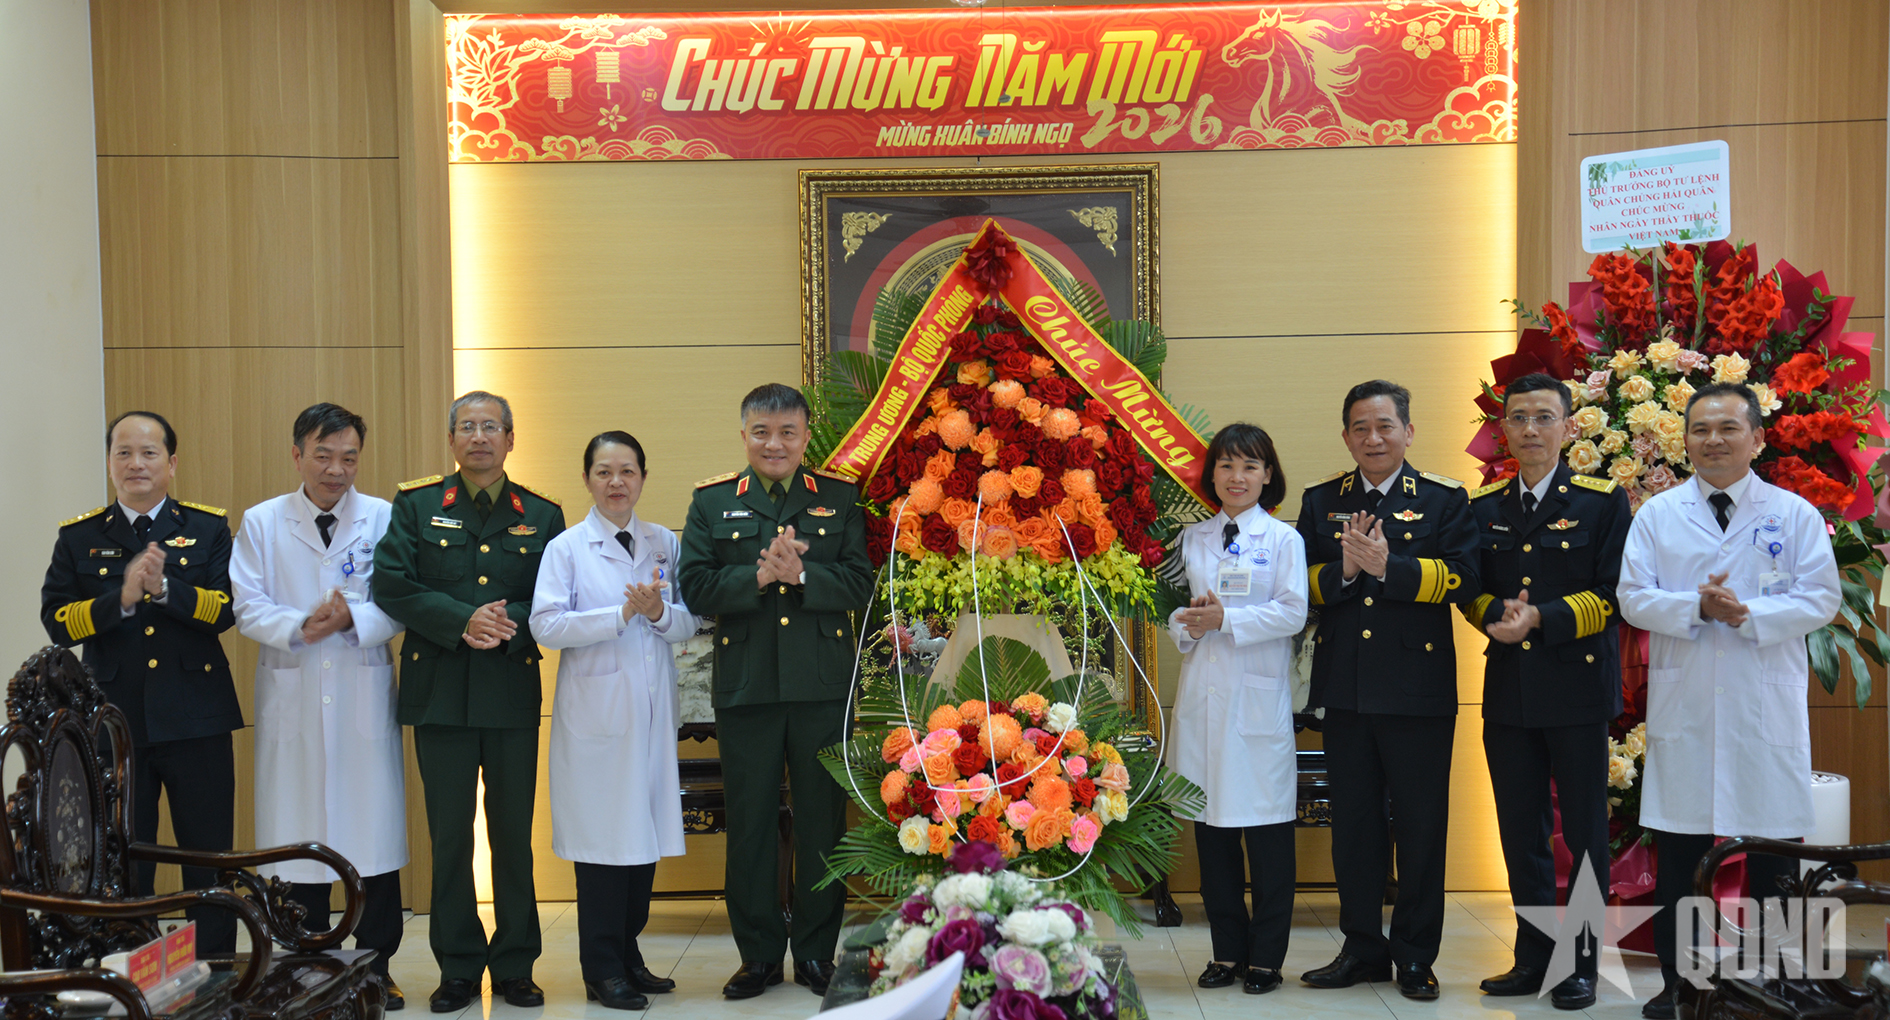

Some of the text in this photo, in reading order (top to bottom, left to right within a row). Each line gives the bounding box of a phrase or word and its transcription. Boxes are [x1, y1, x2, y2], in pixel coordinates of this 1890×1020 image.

[661, 30, 1202, 114] CHÚC MỪNG NĂM MỚI
[876, 118, 1074, 148] MỪNG XUÂN BÍNH NGỌ
[1080, 93, 1222, 149] 2026
[1593, 196, 1621, 210] QUÂN
[1684, 185, 1714, 198] QUÂN
[1656, 178, 1671, 189] BỘ
[1673, 175, 1689, 186] TƯ
[1691, 173, 1720, 185] LỆNH
[1590, 221, 1617, 232] NHÂN
[1620, 217, 1649, 230] NGÀY
[1621, 202, 1685, 217] CHÚC MỪNG
[1628, 228, 1679, 241] VIỆT NAM
[933, 284, 975, 333] PHÒNG
[911, 324, 946, 363] QUỐC
[898, 356, 929, 382] BỘ
[1025, 295, 1196, 470] Chúc Mừng
[877, 386, 909, 426] ƯƠNG
[848, 422, 889, 466] TRUNG
